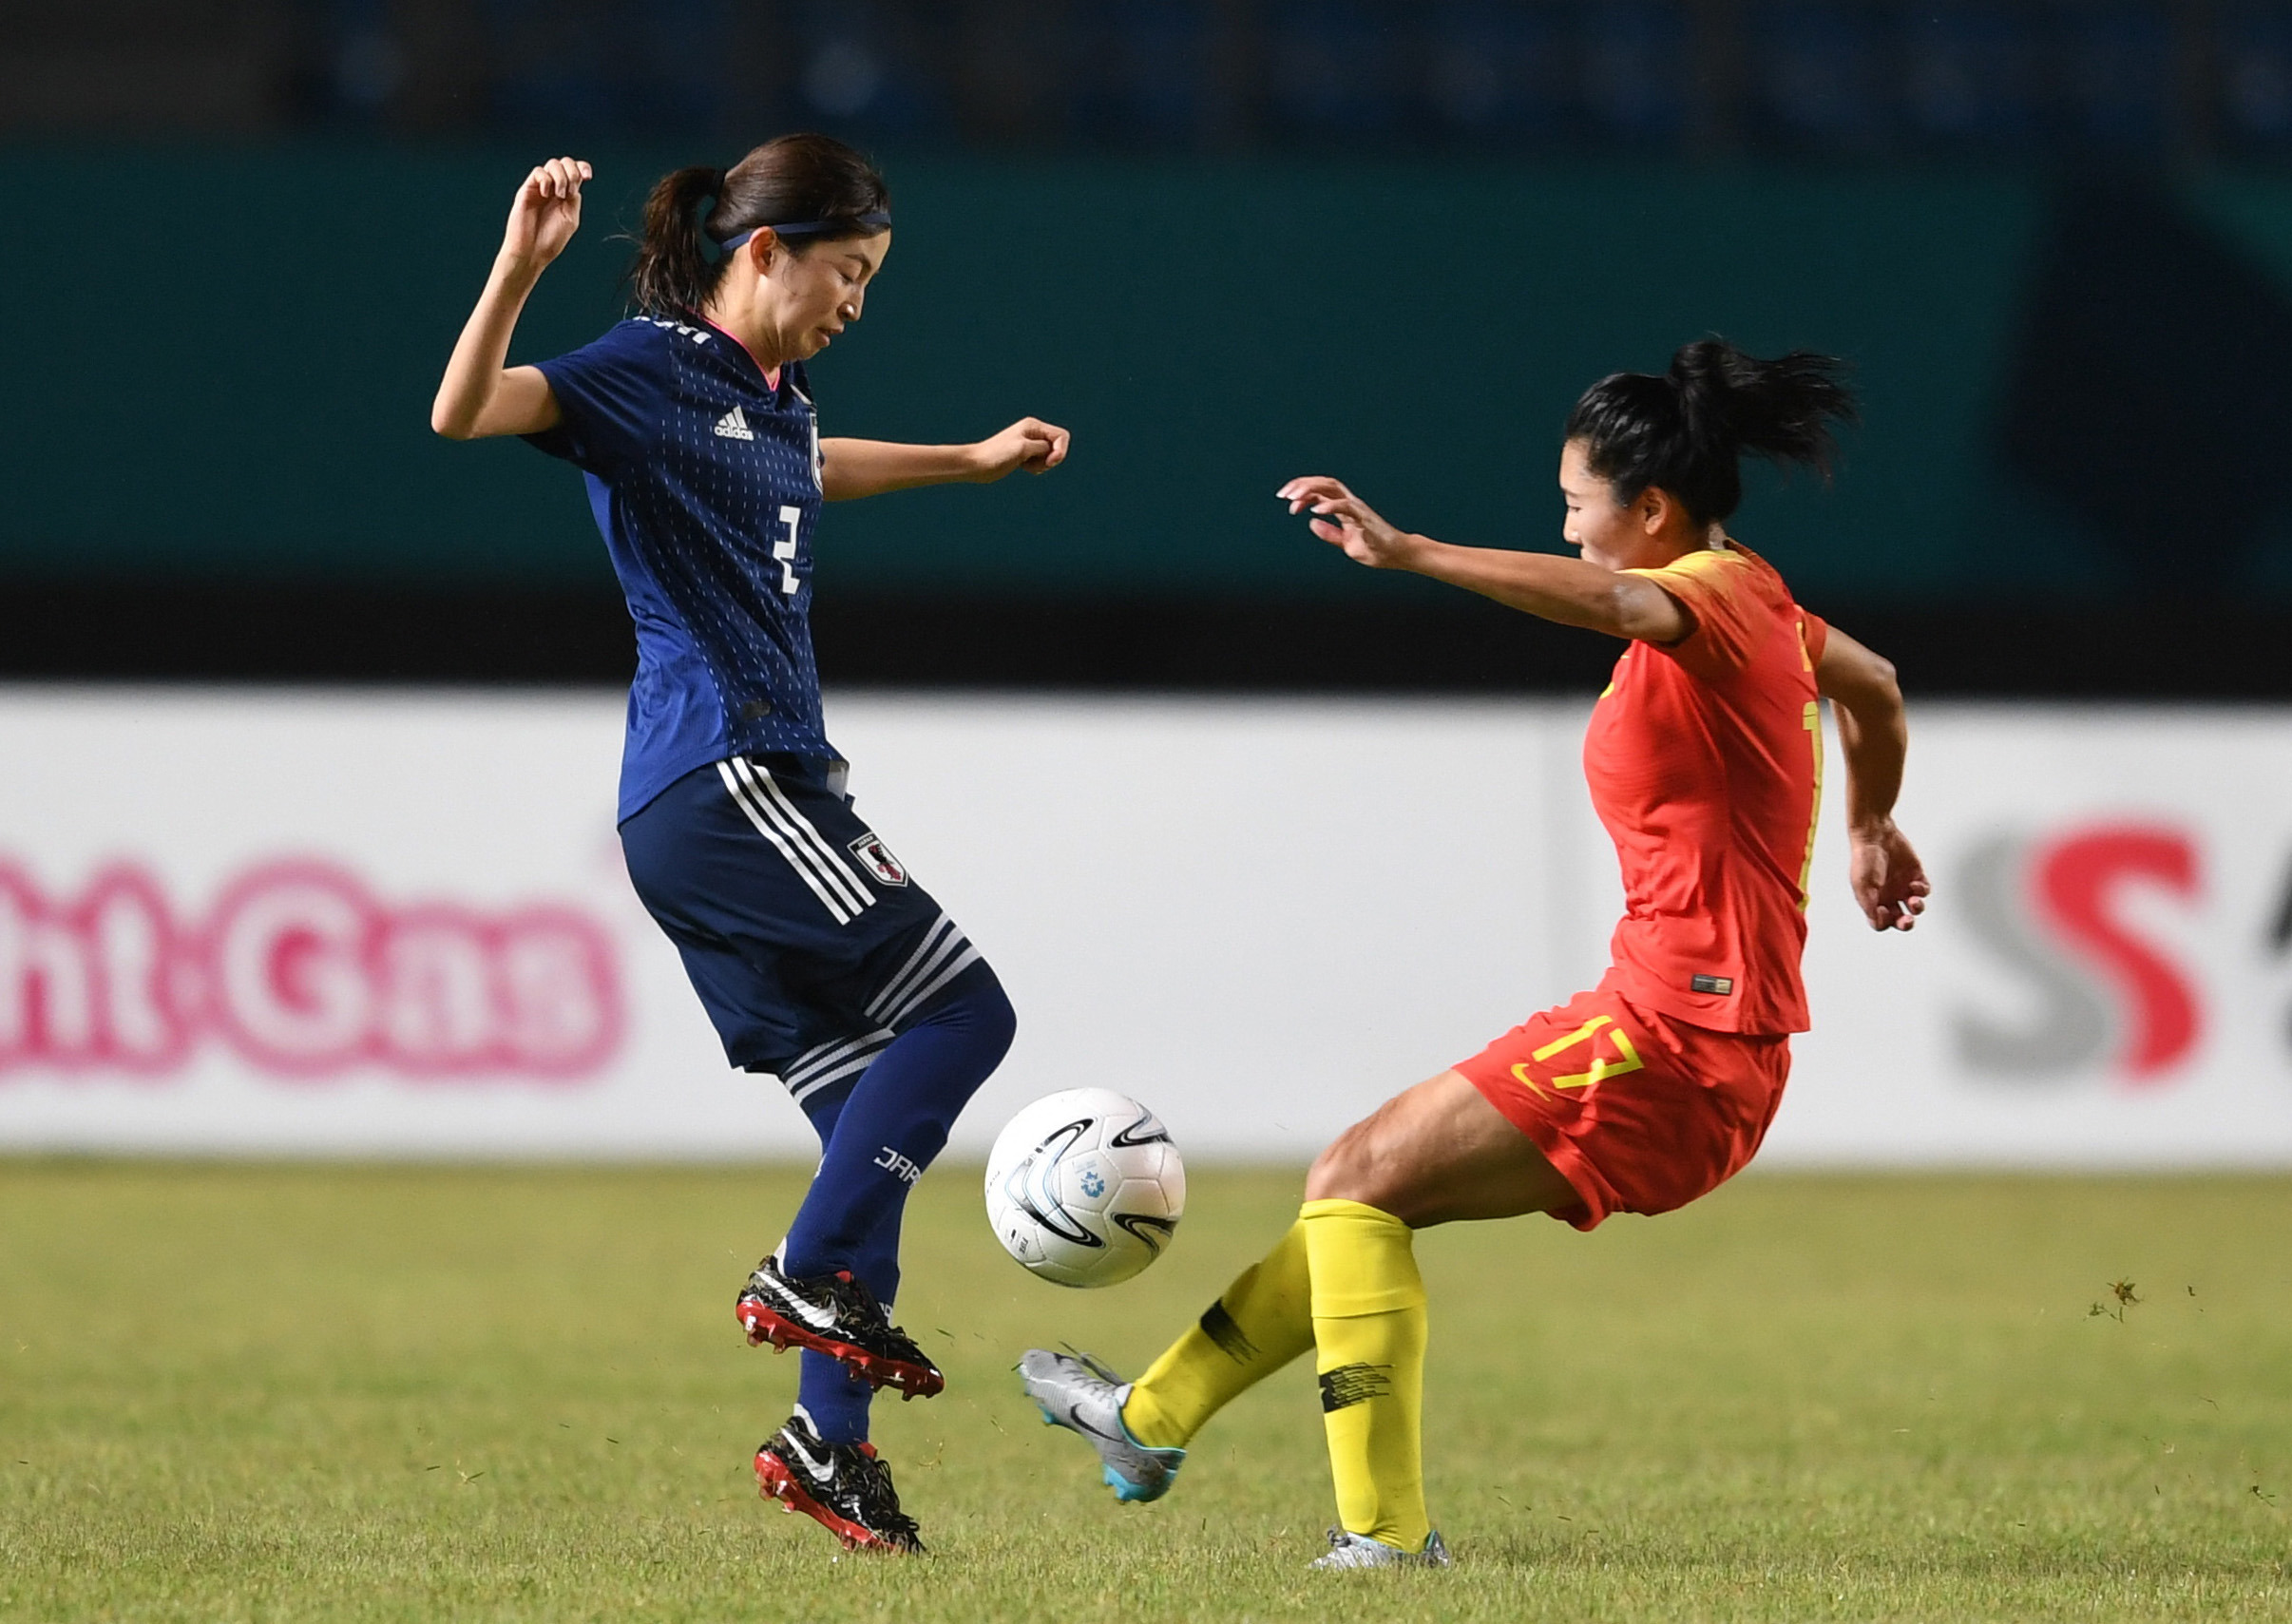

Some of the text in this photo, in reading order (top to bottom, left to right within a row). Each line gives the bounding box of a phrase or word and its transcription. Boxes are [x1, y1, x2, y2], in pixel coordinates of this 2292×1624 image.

[714, 425, 754, 441] adidas
[772, 505, 801, 595] 2
[211, 853, 627, 1081] Gas
[1531, 1014, 1645, 1089] 17
